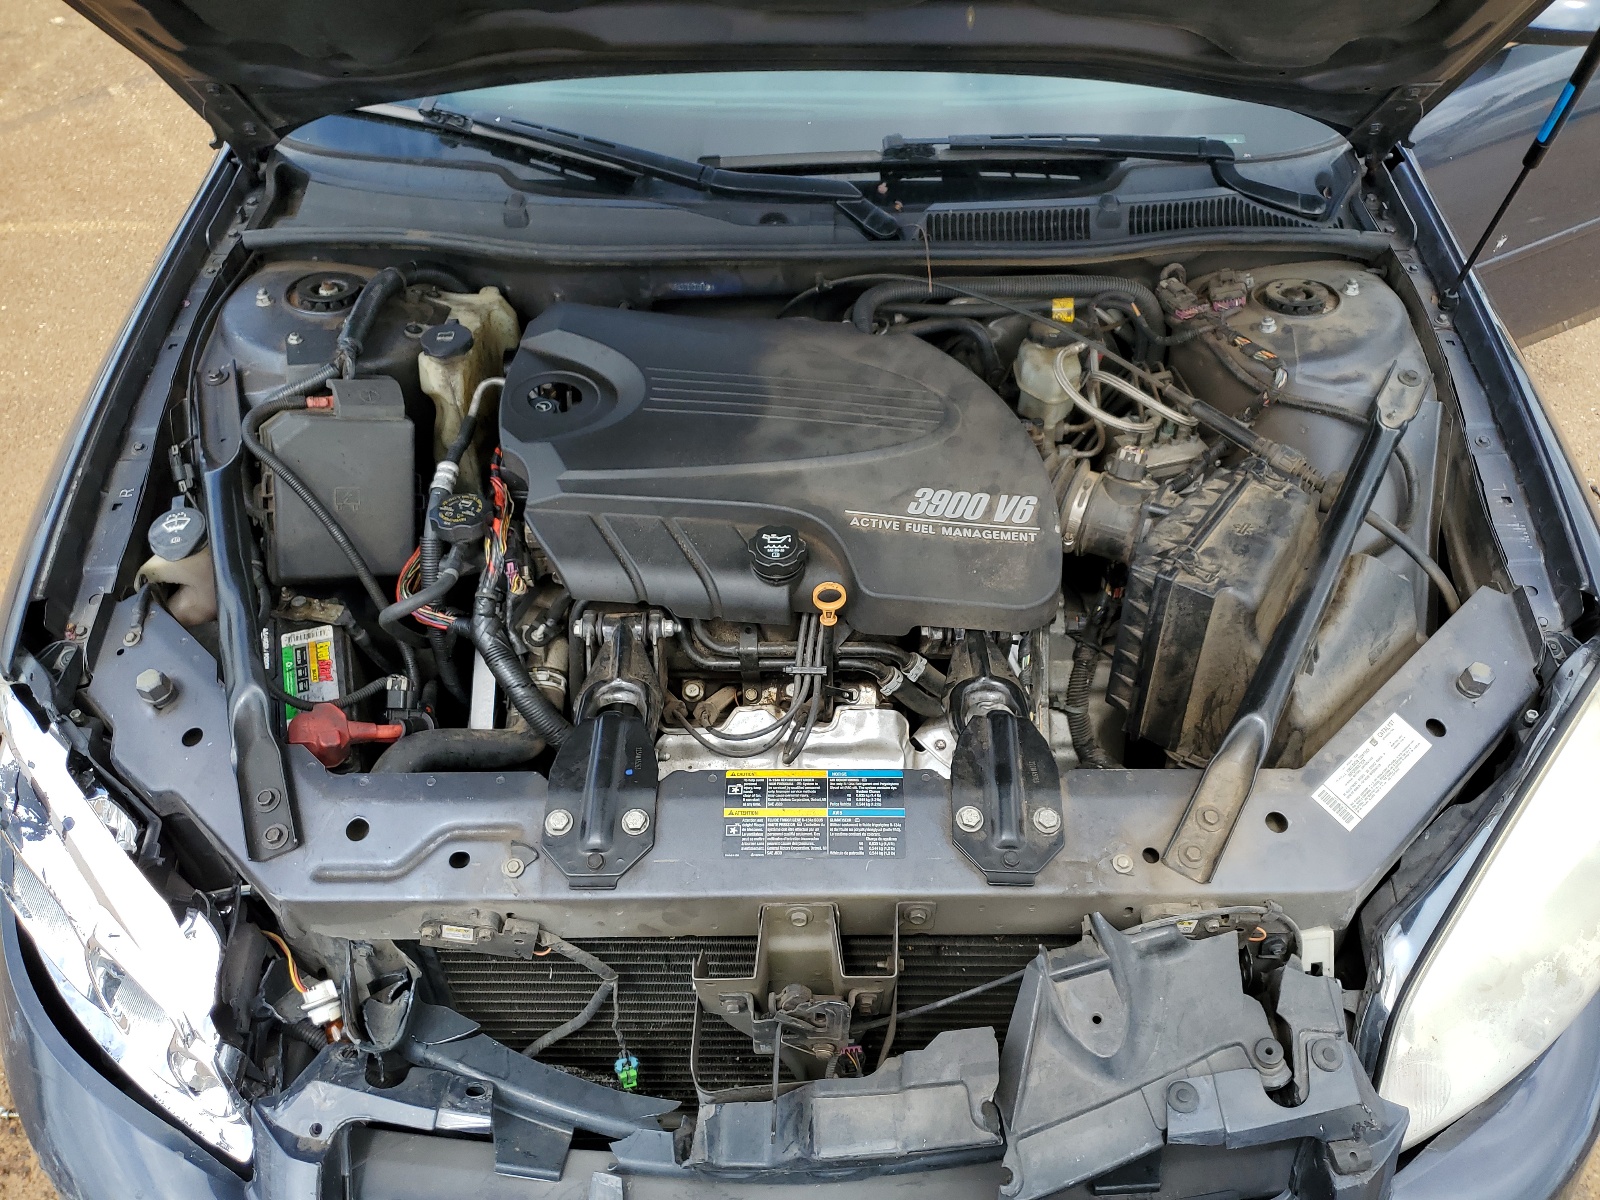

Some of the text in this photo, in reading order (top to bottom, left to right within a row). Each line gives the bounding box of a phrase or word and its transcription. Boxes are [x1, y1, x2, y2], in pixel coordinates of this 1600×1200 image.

[907, 487, 1038, 524] 3900 V6
[850, 516, 1037, 542] ACTIVE FUEL MANAGEMENT
[316, 641, 334, 682] EverStart
[1377, 719, 1395, 738] CATALYST
